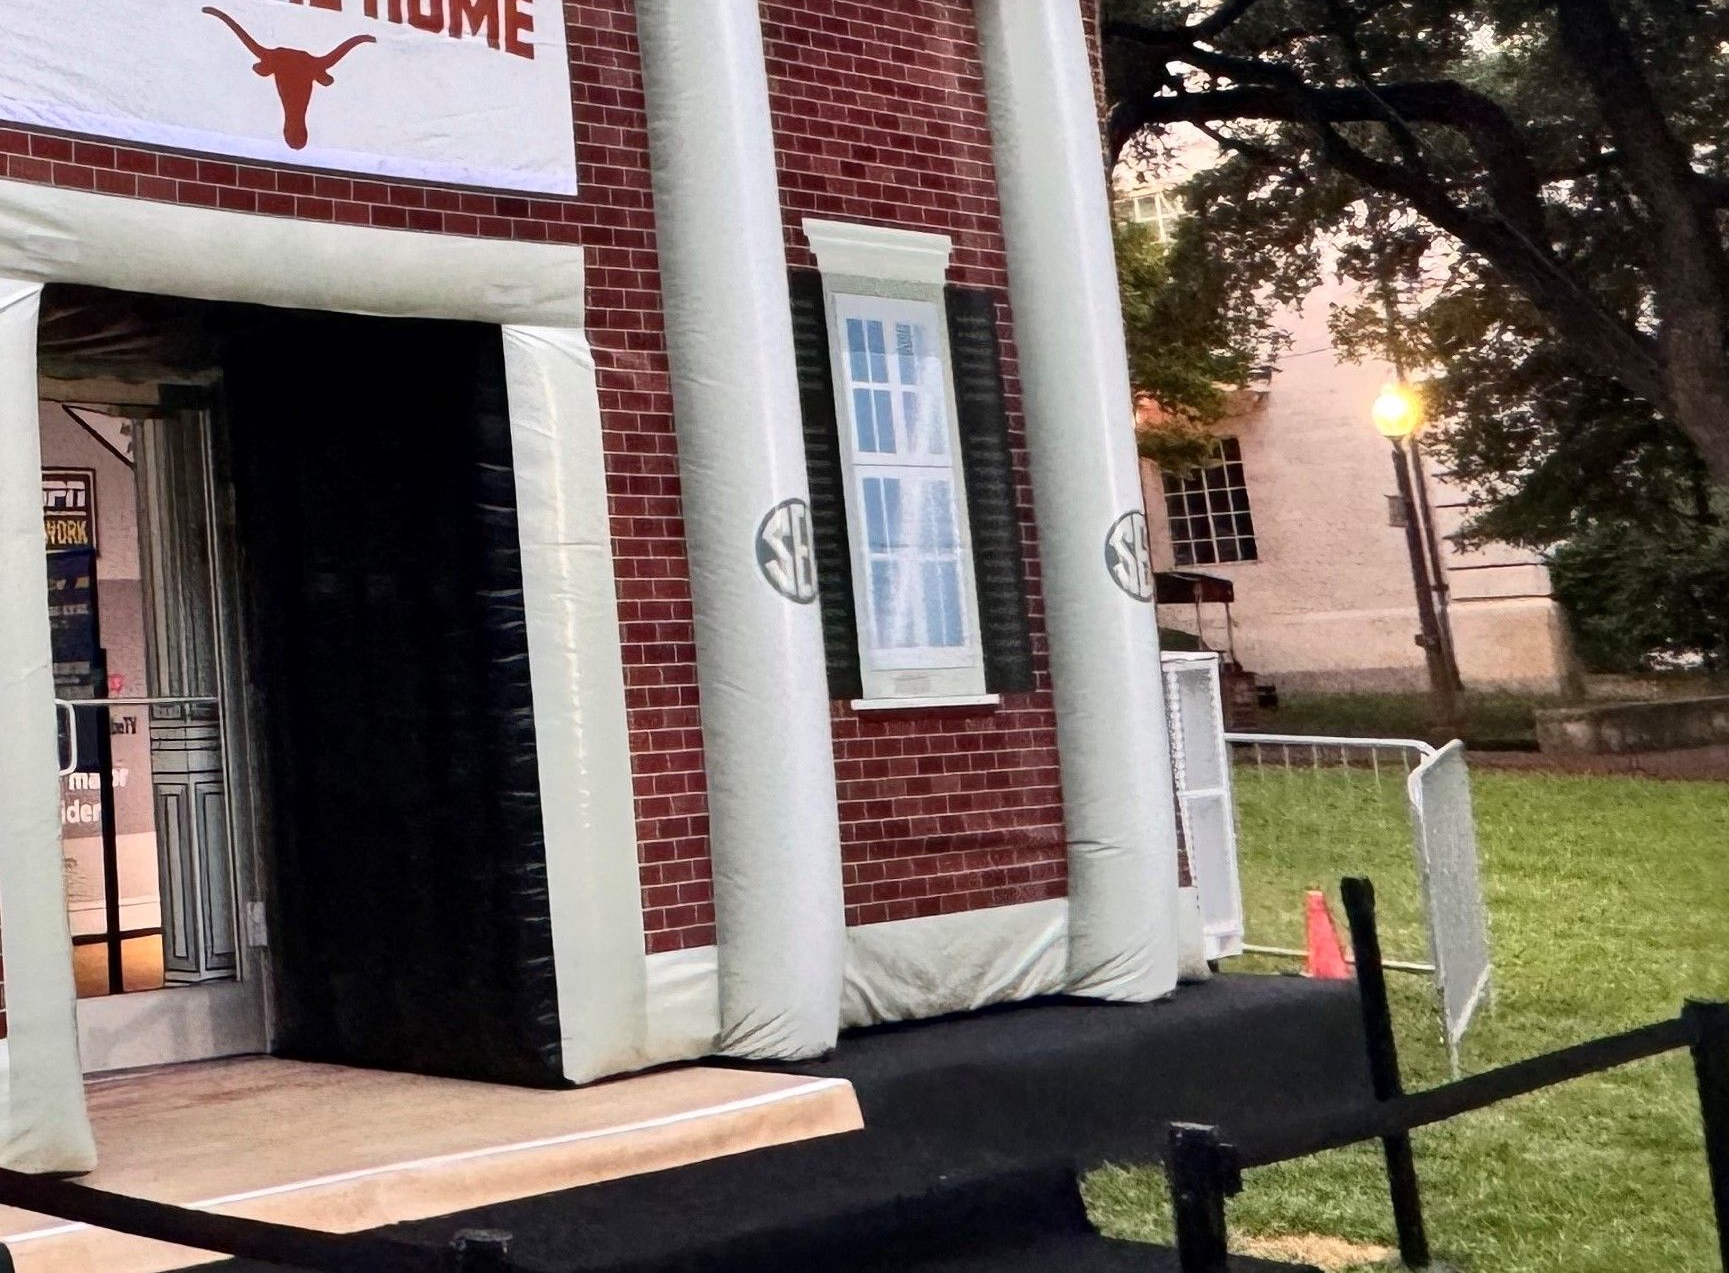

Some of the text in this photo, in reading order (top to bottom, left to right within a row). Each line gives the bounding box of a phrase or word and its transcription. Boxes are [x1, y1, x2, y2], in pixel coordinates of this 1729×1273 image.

[42, 481, 86, 507] PN
[46, 520, 88, 545] WORK
[1109, 513, 1153, 598] SE
